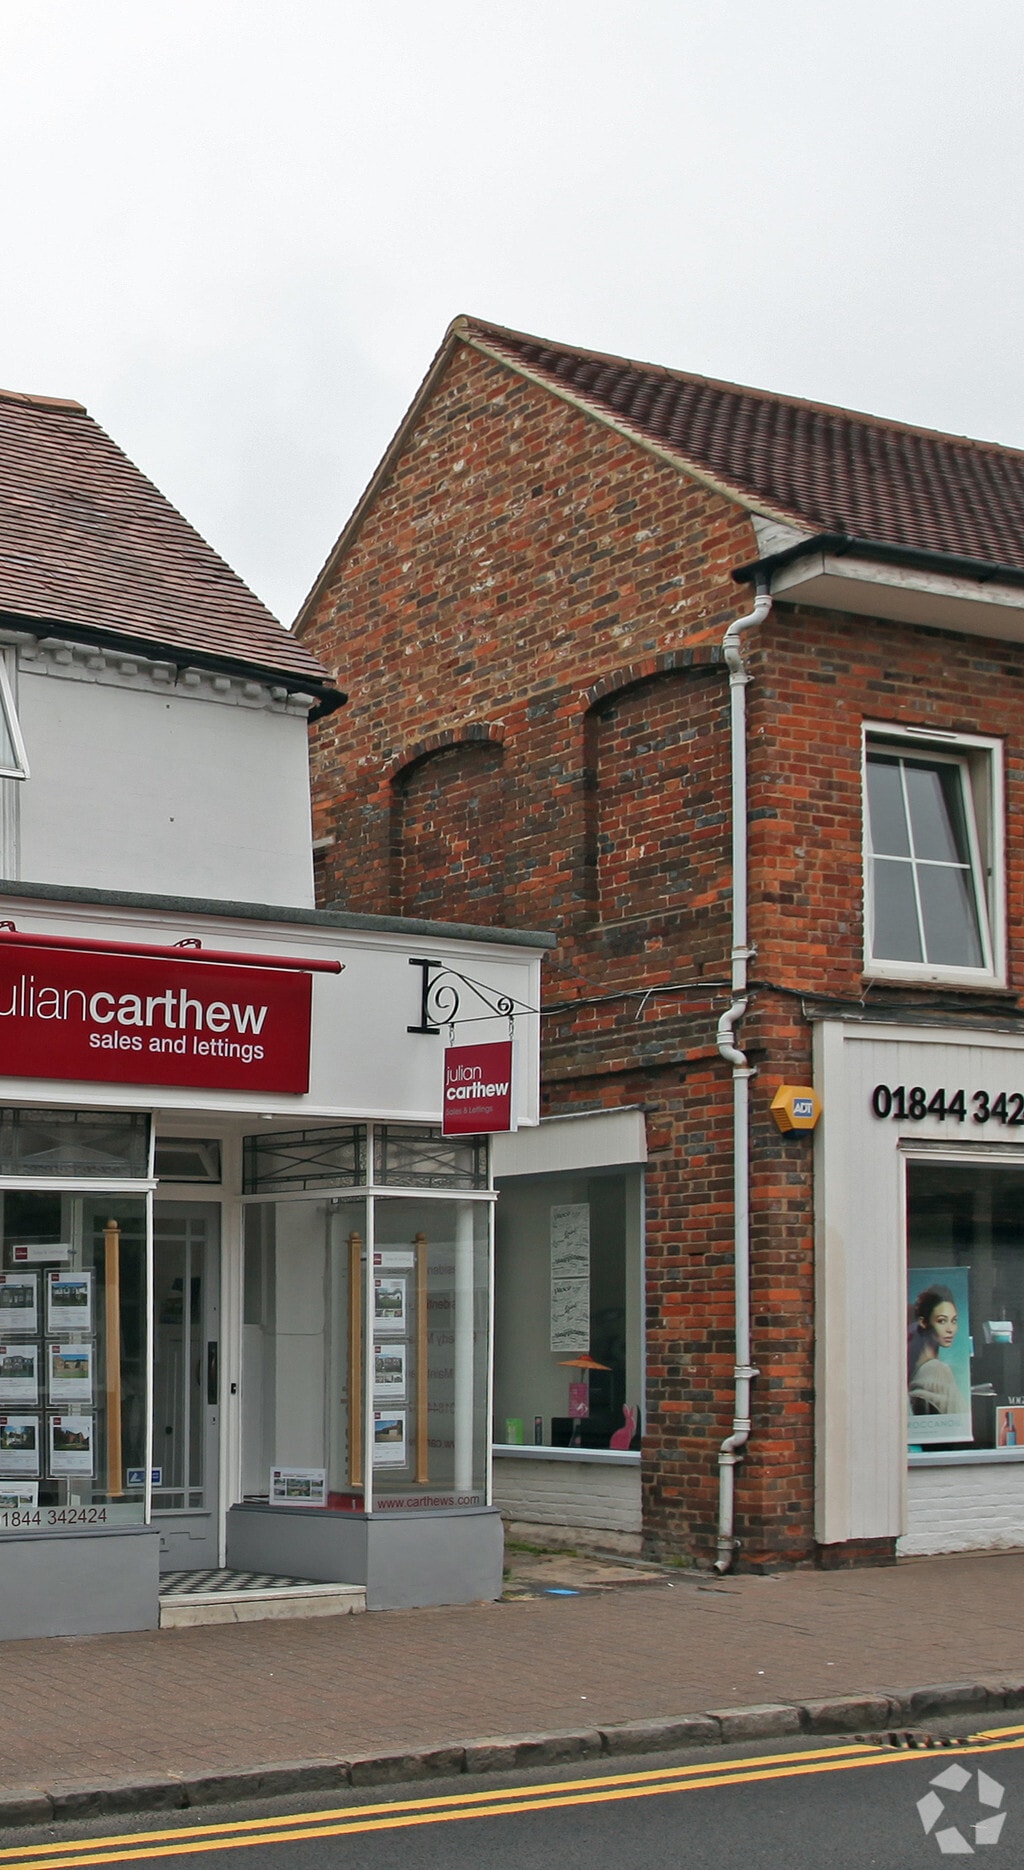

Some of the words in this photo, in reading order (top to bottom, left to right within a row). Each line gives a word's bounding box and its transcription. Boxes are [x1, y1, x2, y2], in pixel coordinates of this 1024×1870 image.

[89, 1030, 143, 1052] sales
[148, 1033, 187, 1055] and
[192, 1035, 265, 1063] lettings
[446, 1065, 482, 1086] julian
[446, 1081, 510, 1101] carthew
[793, 1102, 813, 1114] ADT
[872, 1084, 967, 1123] 01844
[377, 1494, 480, 1509] www.carthews.com
[47, 1507, 108, 1525] 342424
